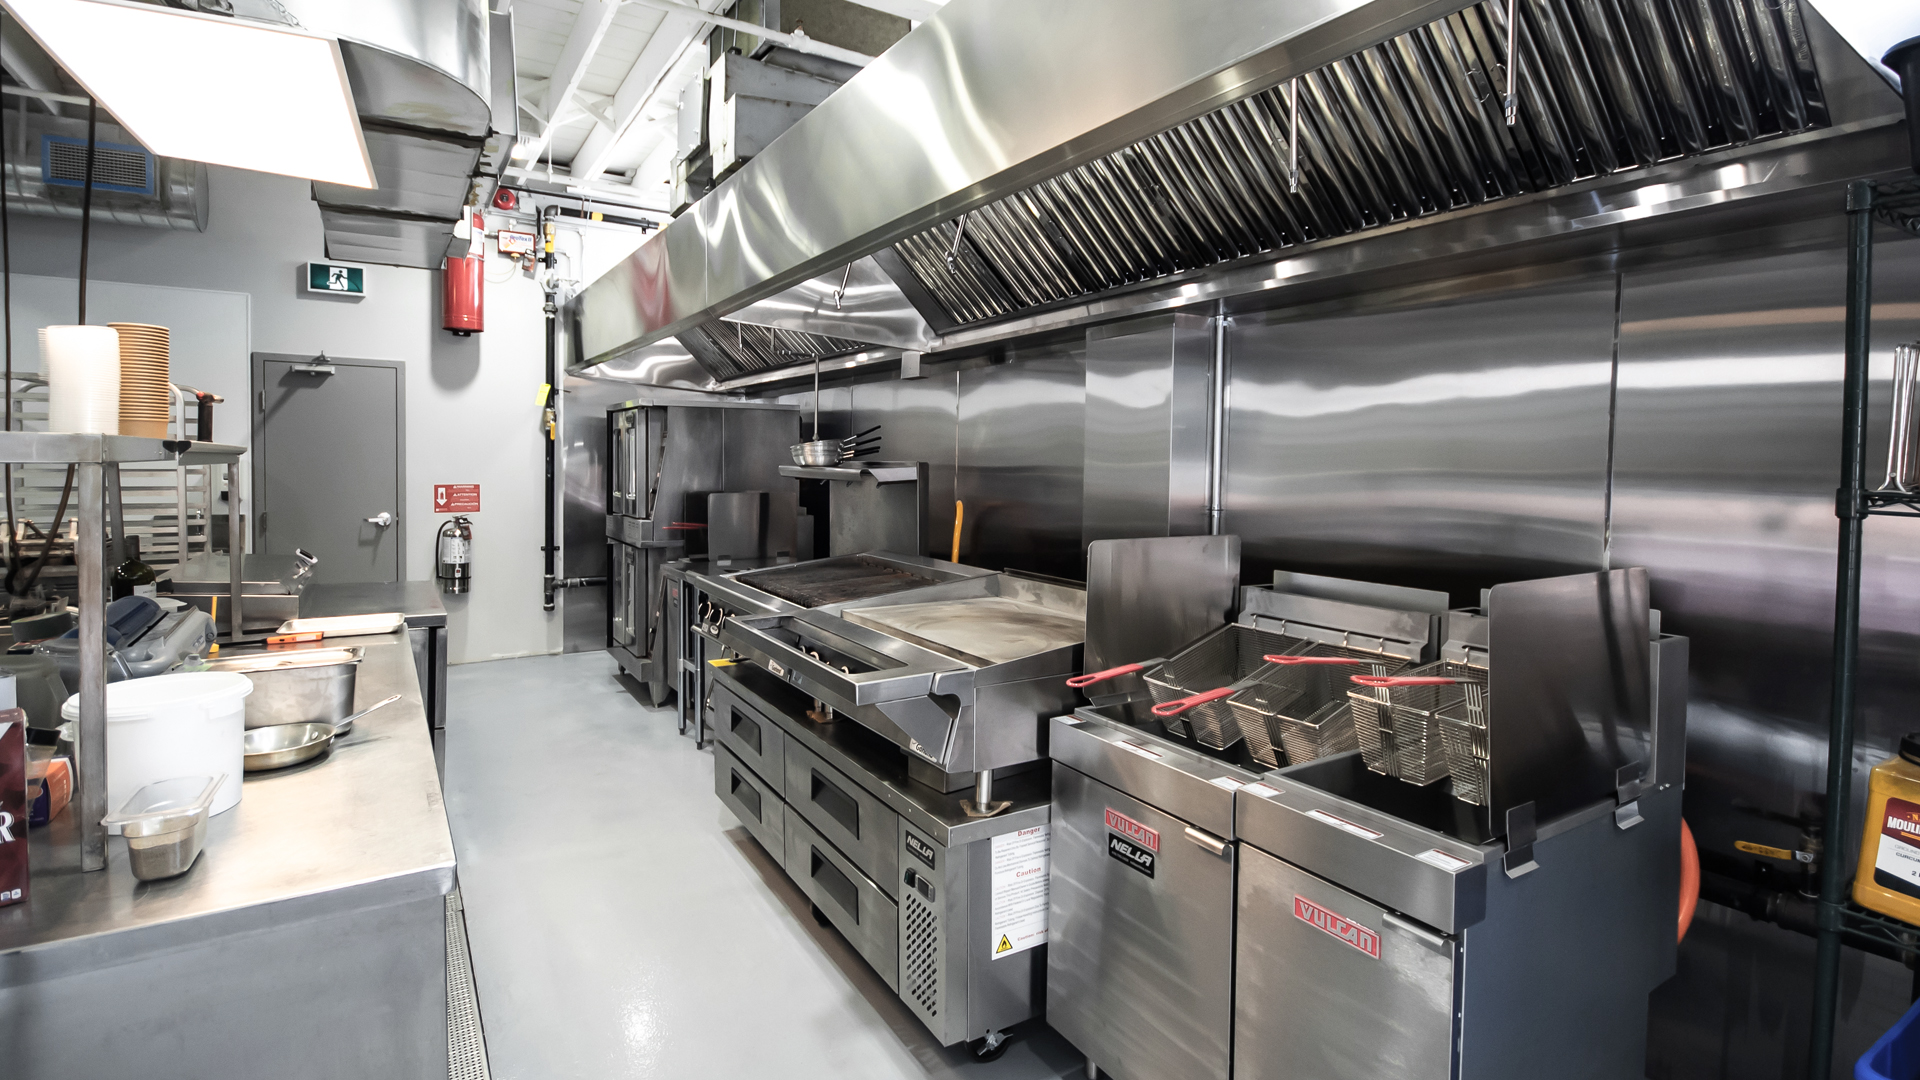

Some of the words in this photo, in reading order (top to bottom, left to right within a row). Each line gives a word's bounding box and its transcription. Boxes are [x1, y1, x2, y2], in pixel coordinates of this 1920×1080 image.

[1018, 827, 1040, 836] Danger
[1108, 812, 1154, 847] VULCAN
[1887, 816, 1920, 835] MOULI
[907, 835, 934, 860] NELLA
[1110, 838, 1153, 867] NELLA
[1016, 867, 1041, 878] Caution
[1300, 901, 1372, 953] VULCAN
